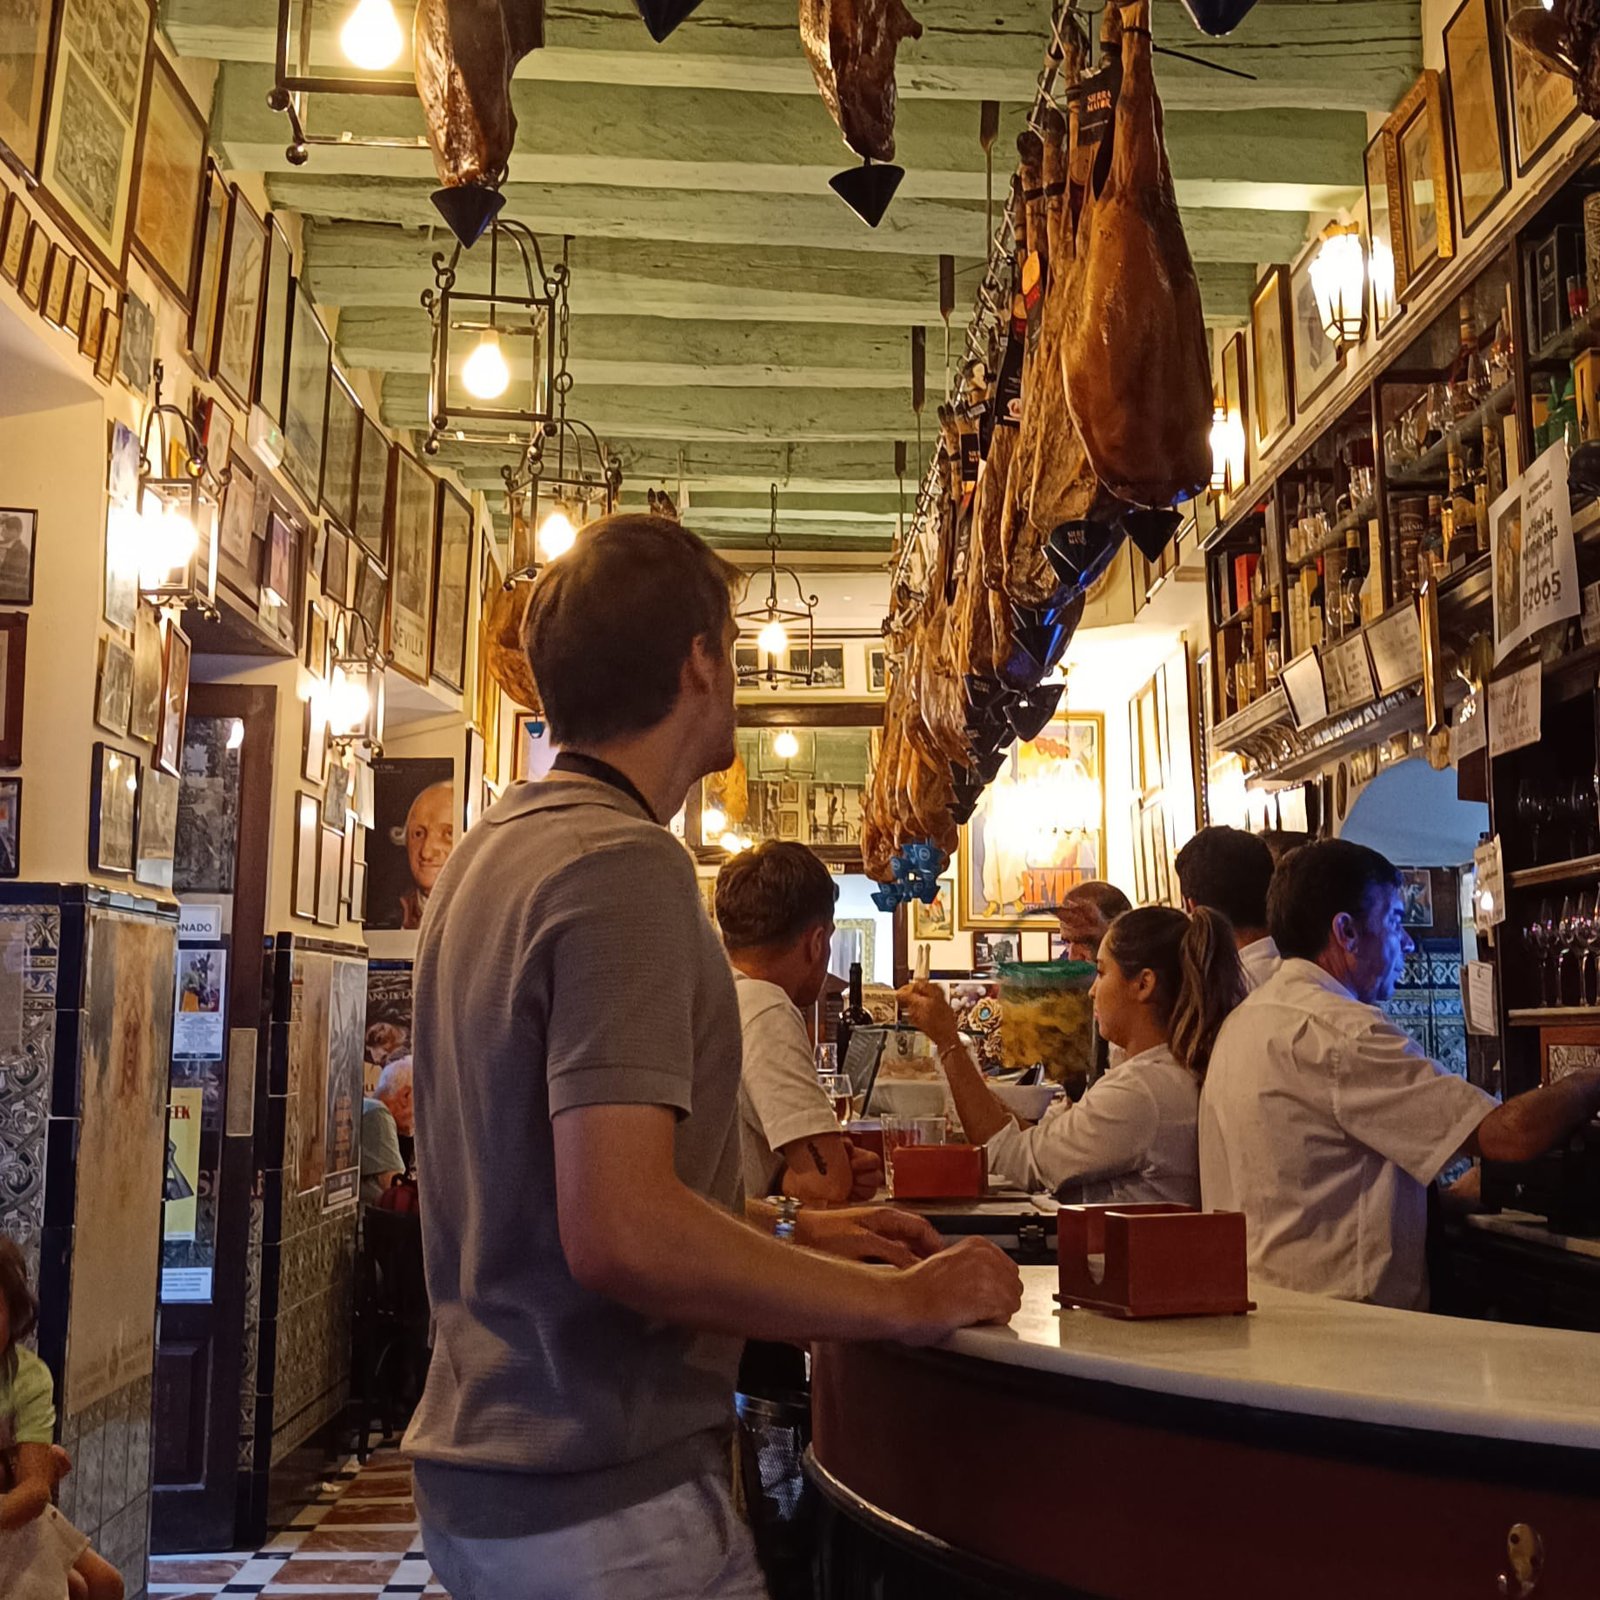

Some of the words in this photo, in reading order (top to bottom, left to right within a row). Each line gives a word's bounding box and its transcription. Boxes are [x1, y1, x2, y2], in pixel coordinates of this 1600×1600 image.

[1087, 90, 1112, 102] SIERRA
[393, 618, 424, 658] SEVILLA
[178, 922, 213, 933] NADO
